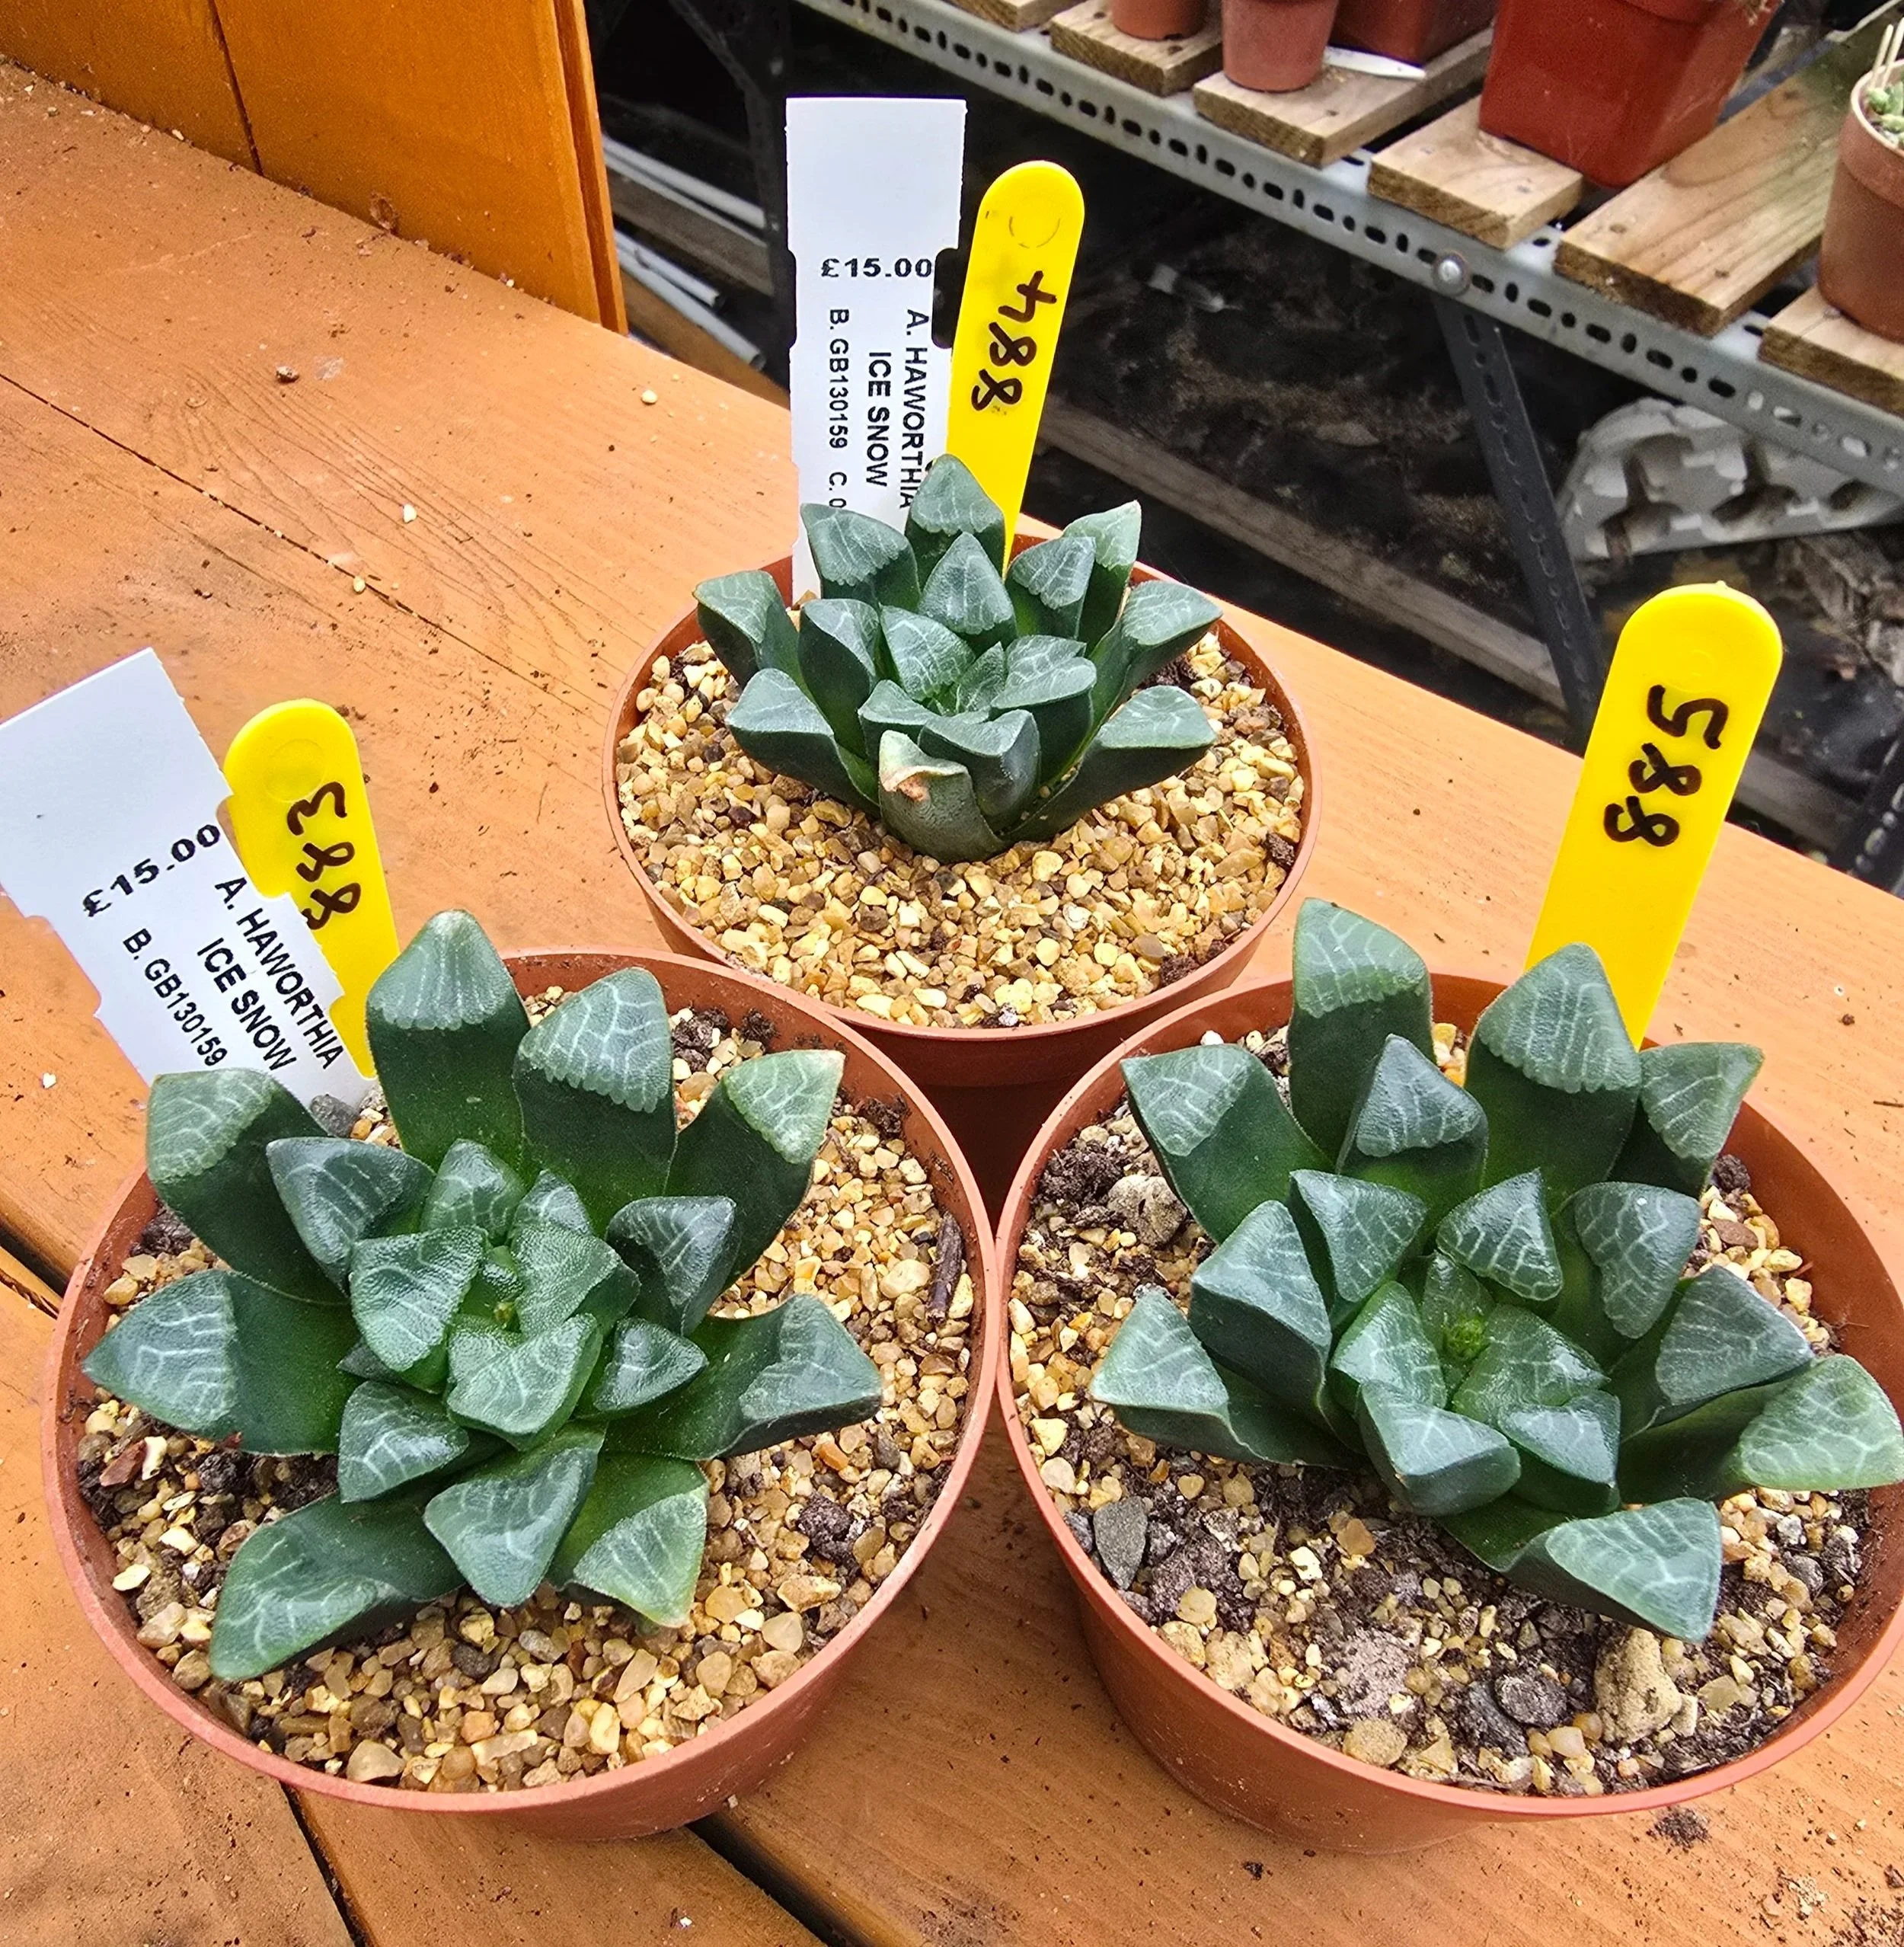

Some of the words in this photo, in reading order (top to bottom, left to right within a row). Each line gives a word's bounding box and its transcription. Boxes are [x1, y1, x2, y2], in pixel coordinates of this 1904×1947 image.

[820, 257, 933, 278] £15.00
[829, 309, 850, 331] B.
[905, 309, 930, 337] A.
[829, 338, 849, 449] GB130159
[867, 351, 892, 398] ICE
[971, 270, 1058, 412] 884
[829, 472, 848, 491] C.
[865, 406, 890, 488] SNOW
[899, 347, 928, 510] HAWORTHIA
[1603, 684, 1729, 847] 885
[81, 823, 221, 918] £15.00
[286, 782, 361, 930] 883
[122, 927, 152, 961] B.
[143, 958, 228, 1067] GB130159
[196, 937, 248, 995] ICE
[232, 989, 298, 1072] SNOW
[215, 876, 248, 910] A.
[236, 907, 344, 1070] HAWORTHIA
